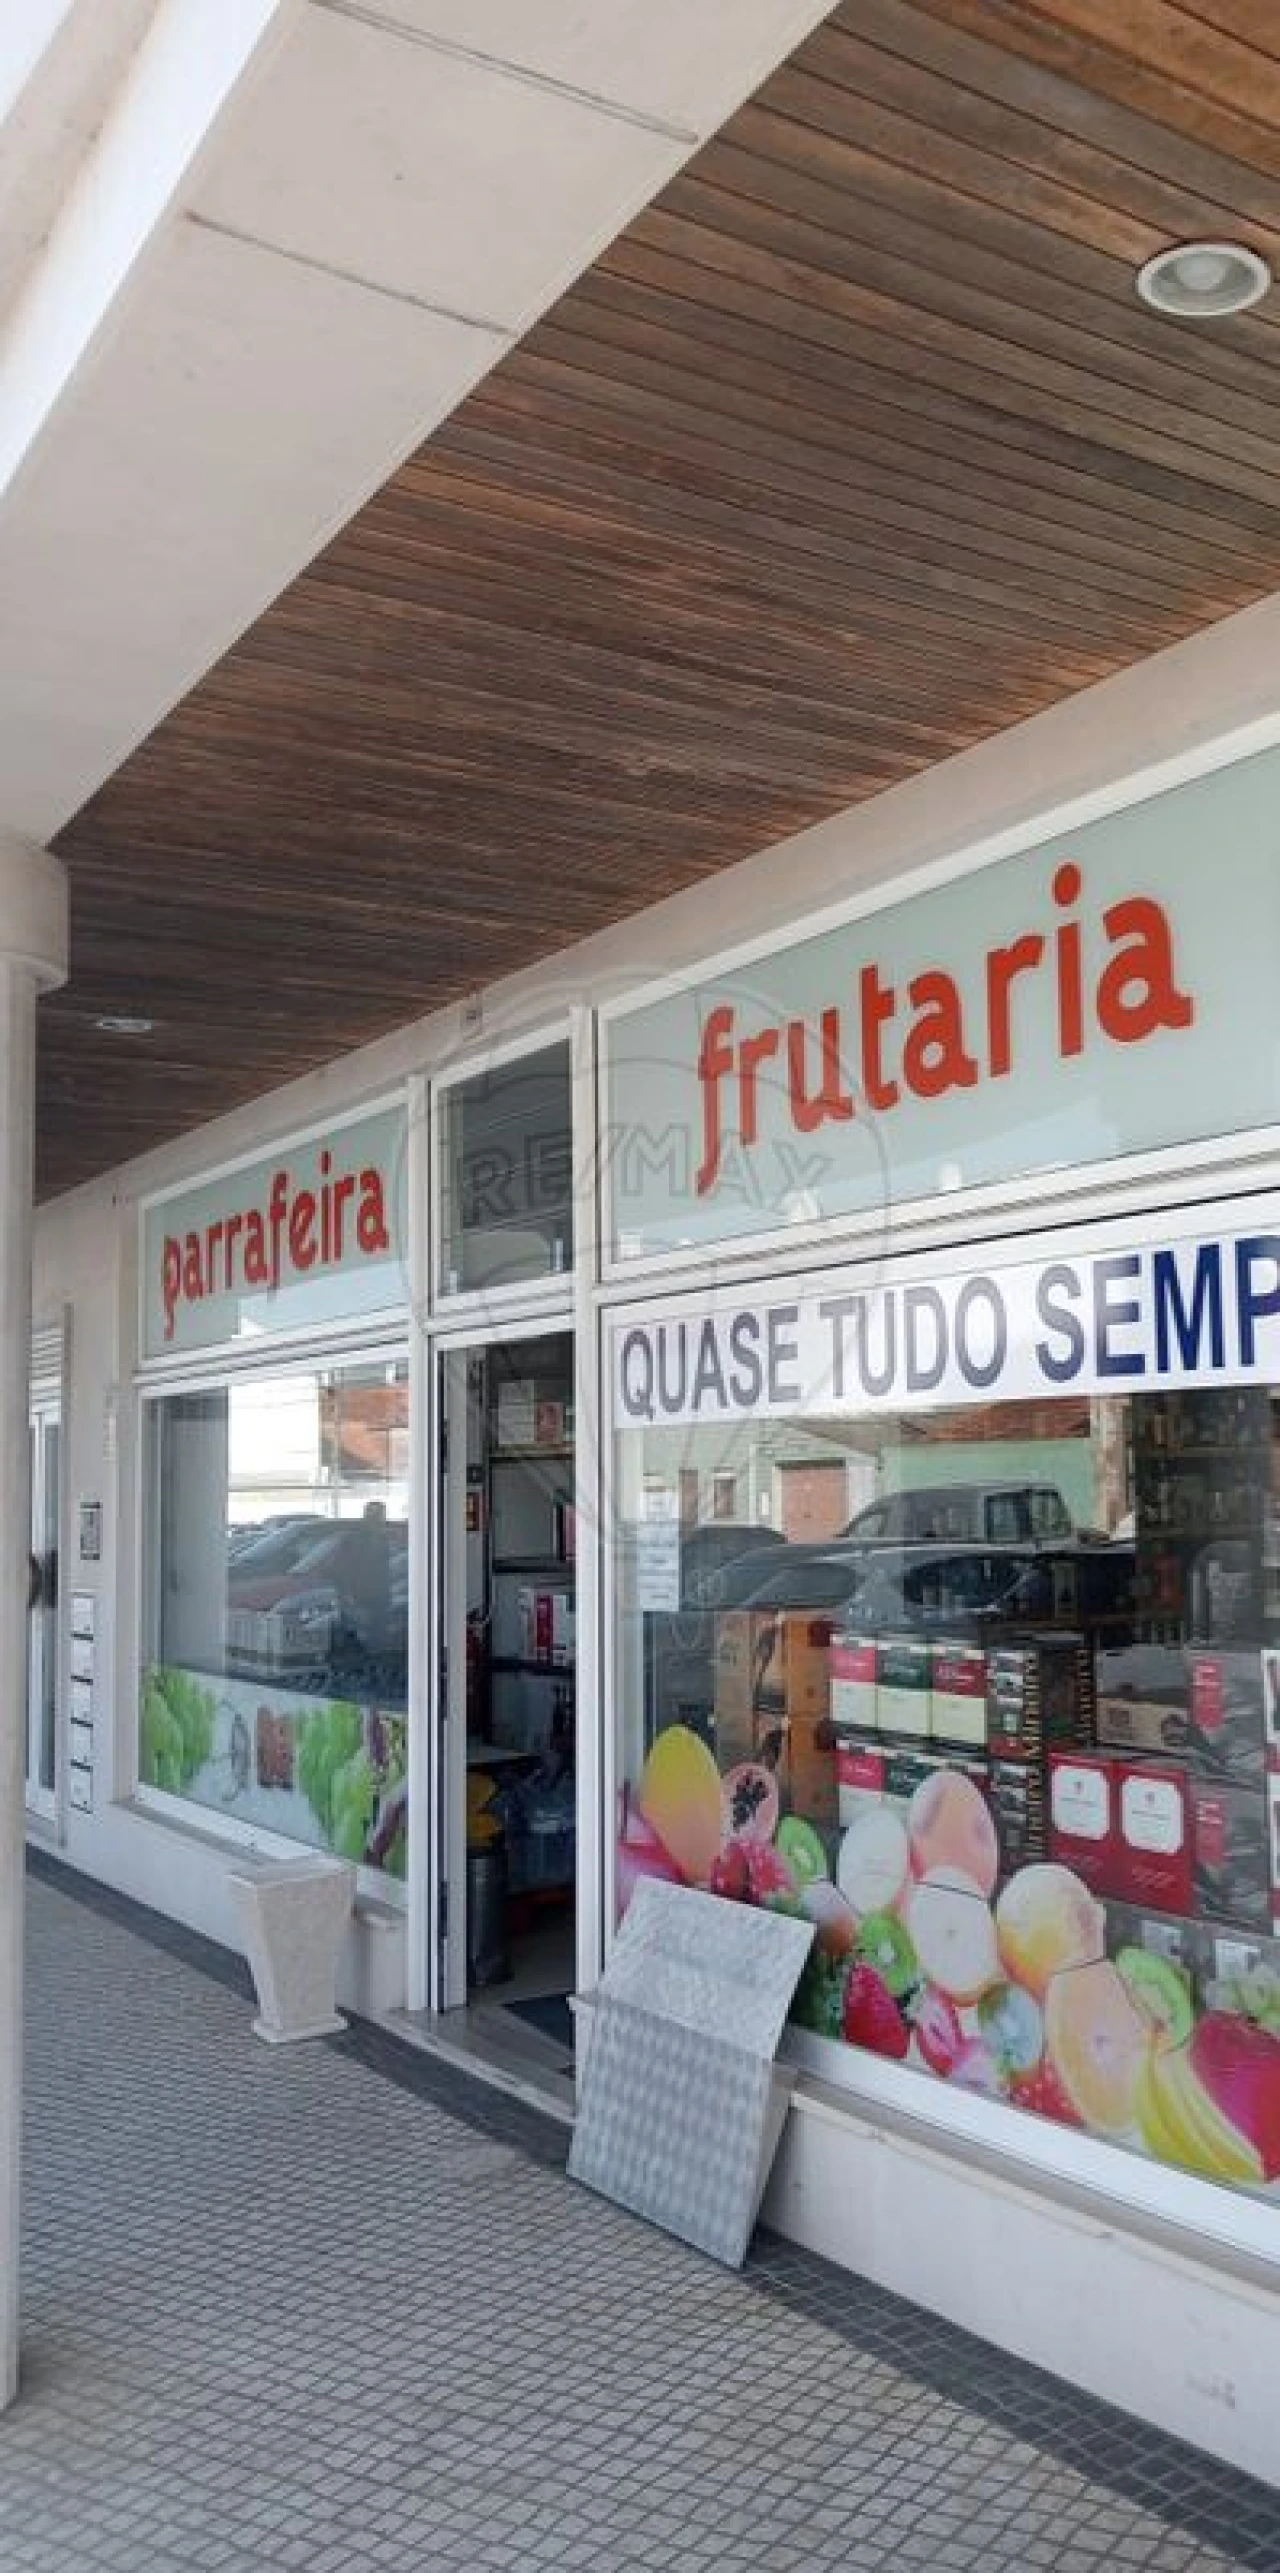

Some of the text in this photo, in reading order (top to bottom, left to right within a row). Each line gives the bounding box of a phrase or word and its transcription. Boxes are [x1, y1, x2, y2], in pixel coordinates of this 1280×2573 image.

[696, 860, 1196, 1195] frutaria
[620, 1235, 1280, 1421] QUASE TUDO SEMP
